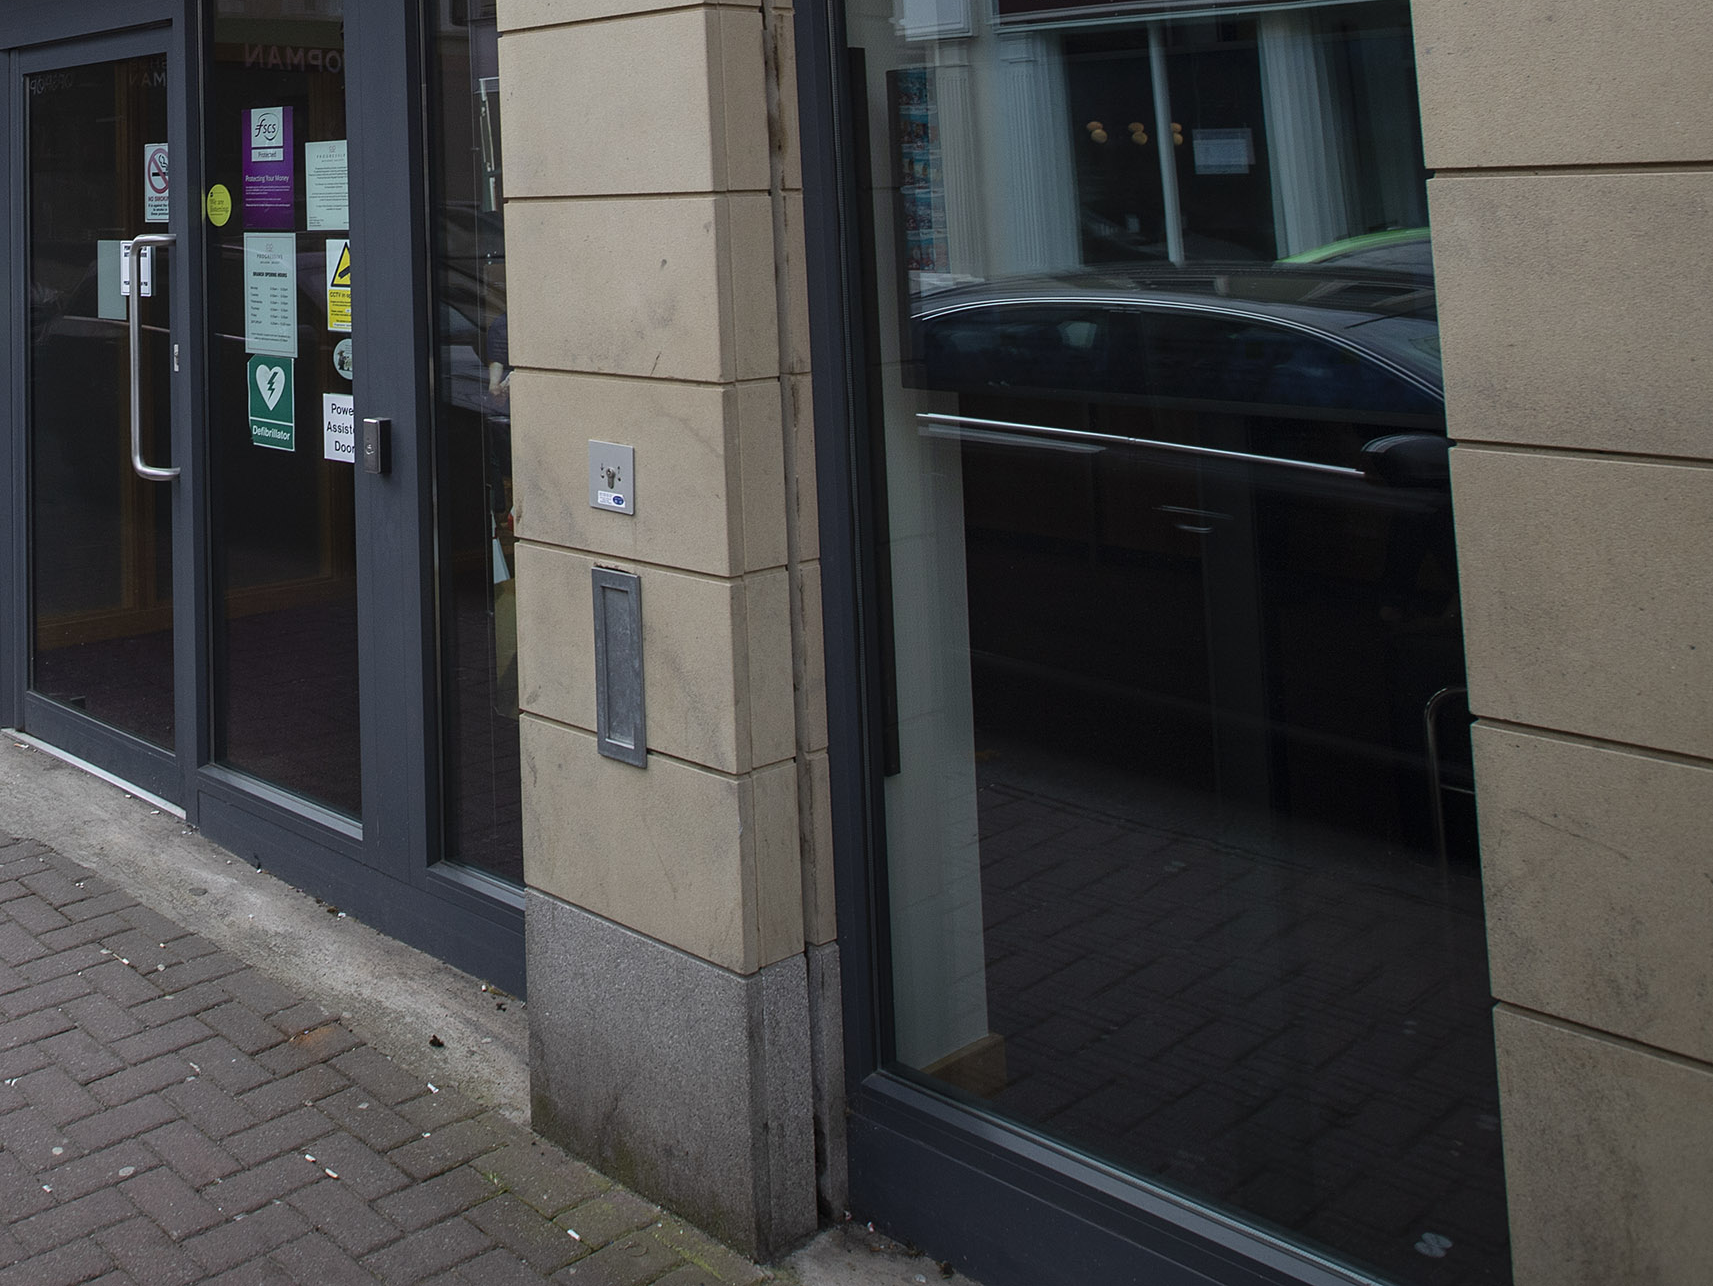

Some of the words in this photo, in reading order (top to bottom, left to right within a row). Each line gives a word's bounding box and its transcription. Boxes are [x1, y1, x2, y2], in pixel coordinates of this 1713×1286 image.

[330, 402, 354, 416] Powe
[252, 425, 291, 442] Defibrillator
[326, 420, 354, 435] Assist
